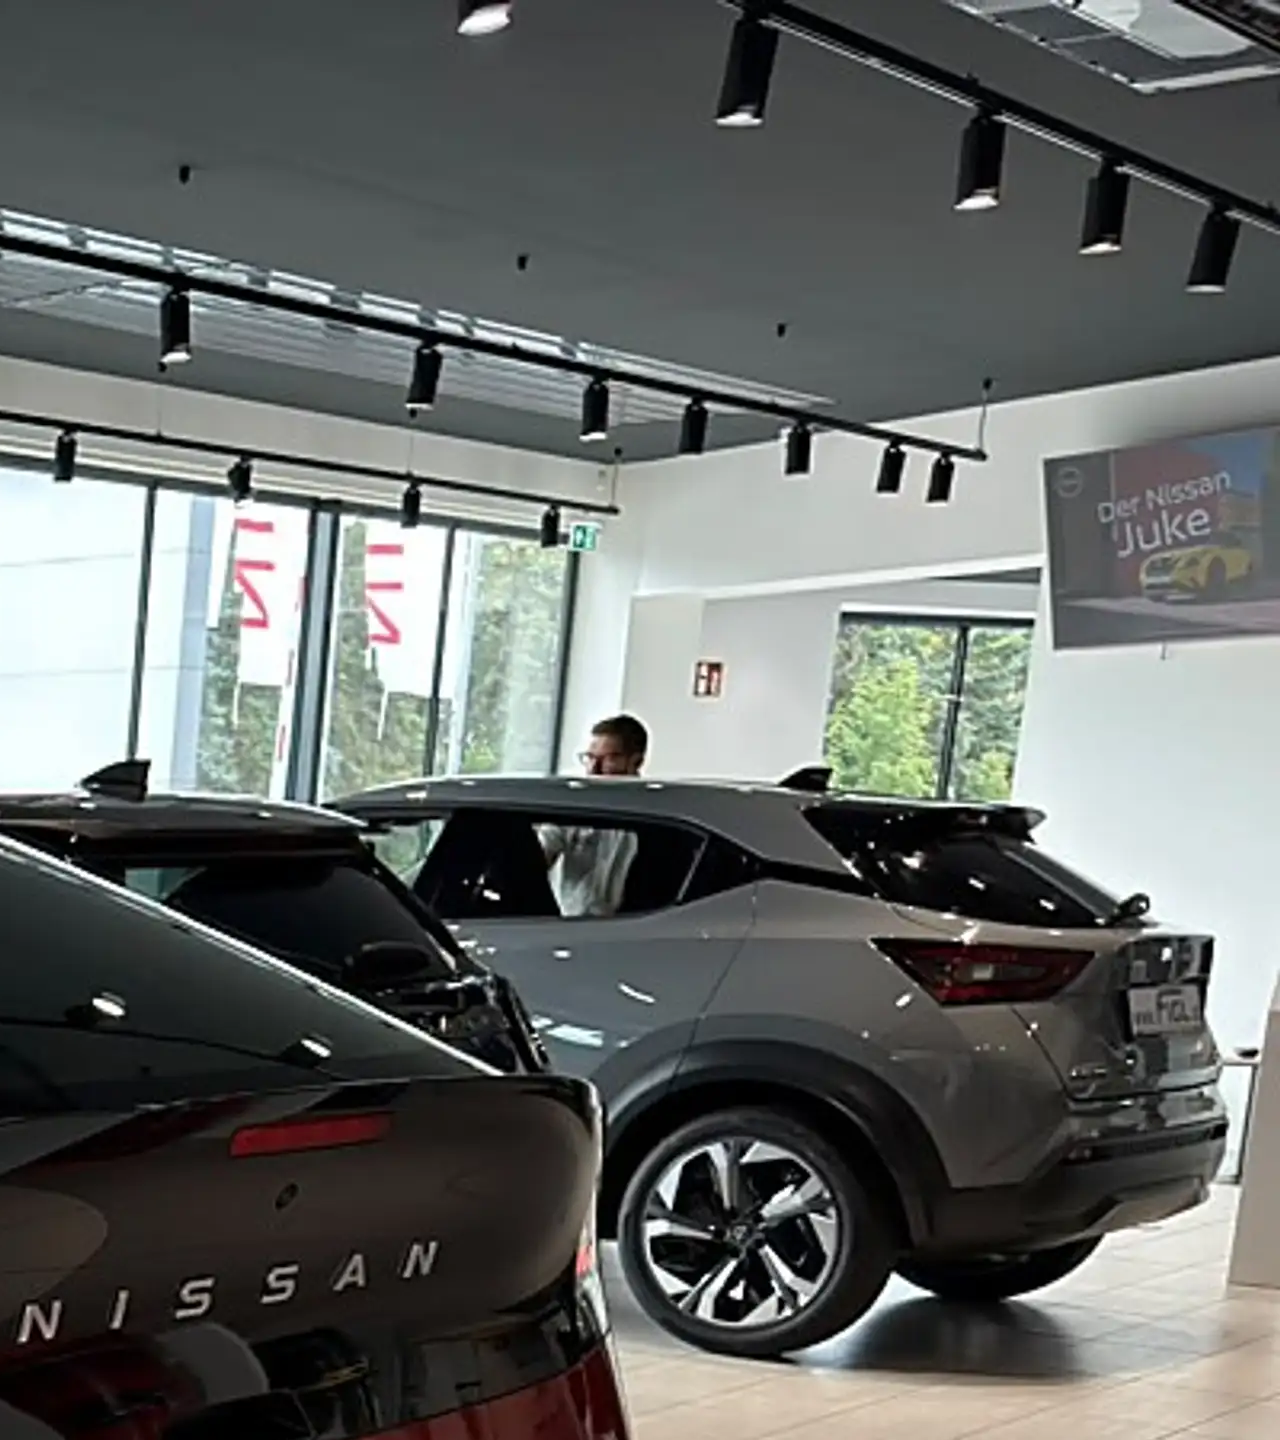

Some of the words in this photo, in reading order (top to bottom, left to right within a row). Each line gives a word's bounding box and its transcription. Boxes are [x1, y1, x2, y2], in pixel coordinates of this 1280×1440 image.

[1097, 496, 1140, 524] Der
[1145, 469, 1232, 511] Nissan
[1117, 507, 1212, 558] Juke
[16, 1241, 438, 1344] NISSAN
